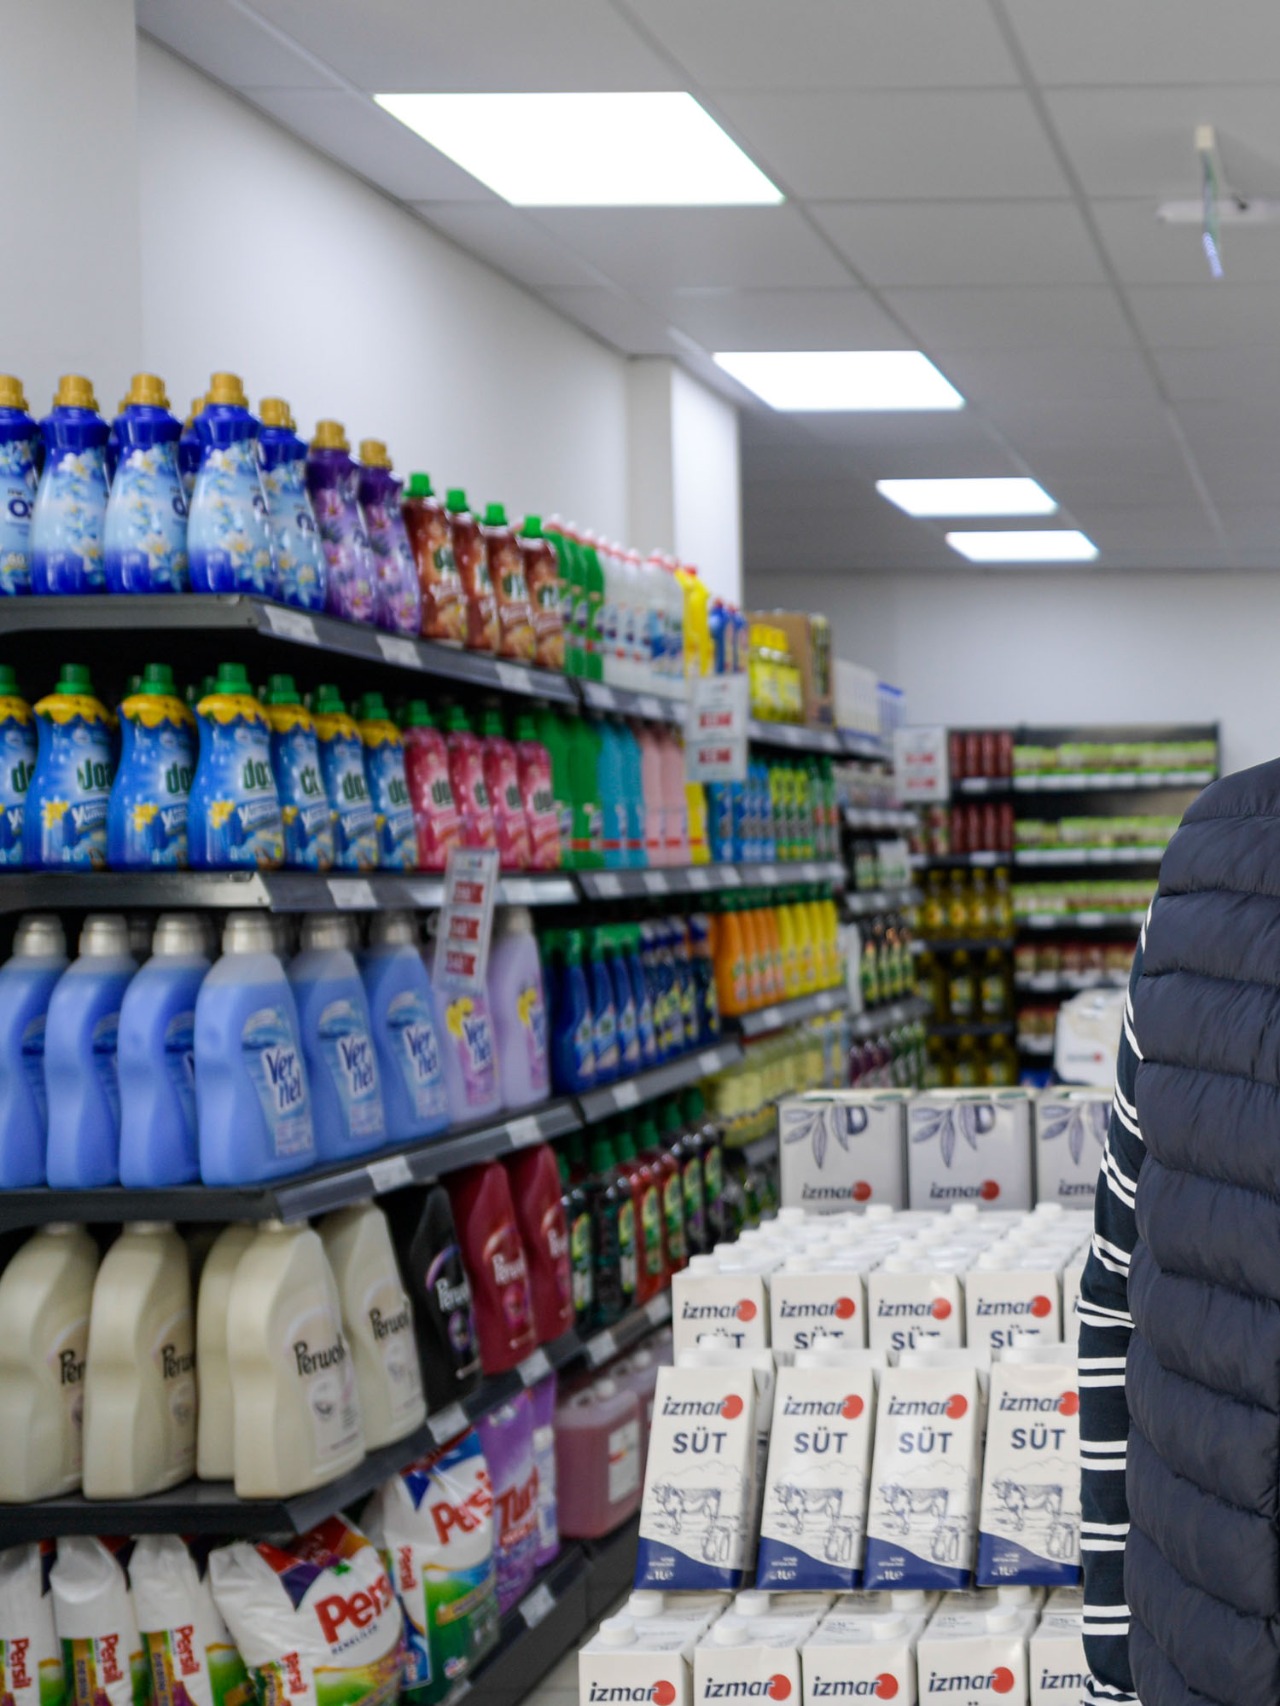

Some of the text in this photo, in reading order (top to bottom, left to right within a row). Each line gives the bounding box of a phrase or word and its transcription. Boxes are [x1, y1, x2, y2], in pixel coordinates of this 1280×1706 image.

[682, 1301, 740, 1320] izmar
[780, 1300, 839, 1318] izmar
[878, 1299, 935, 1317] izmar
[976, 1297, 1035, 1316] izmar
[662, 1396, 727, 1416] izmar
[783, 1396, 848, 1416] izmar
[888, 1395, 952, 1416] izmar
[1000, 1391, 1065, 1412] izmar
[672, 1426, 727, 1453] SÜT
[794, 1426, 848, 1453] SÜT
[899, 1426, 953, 1453] SÜT
[1011, 1423, 1066, 1450] SÜT
[589, 1682, 659, 1702] izmar
[705, 1678, 775, 1699] izmar
[813, 1676, 881, 1697] izmar
[928, 1672, 997, 1693] izmar
